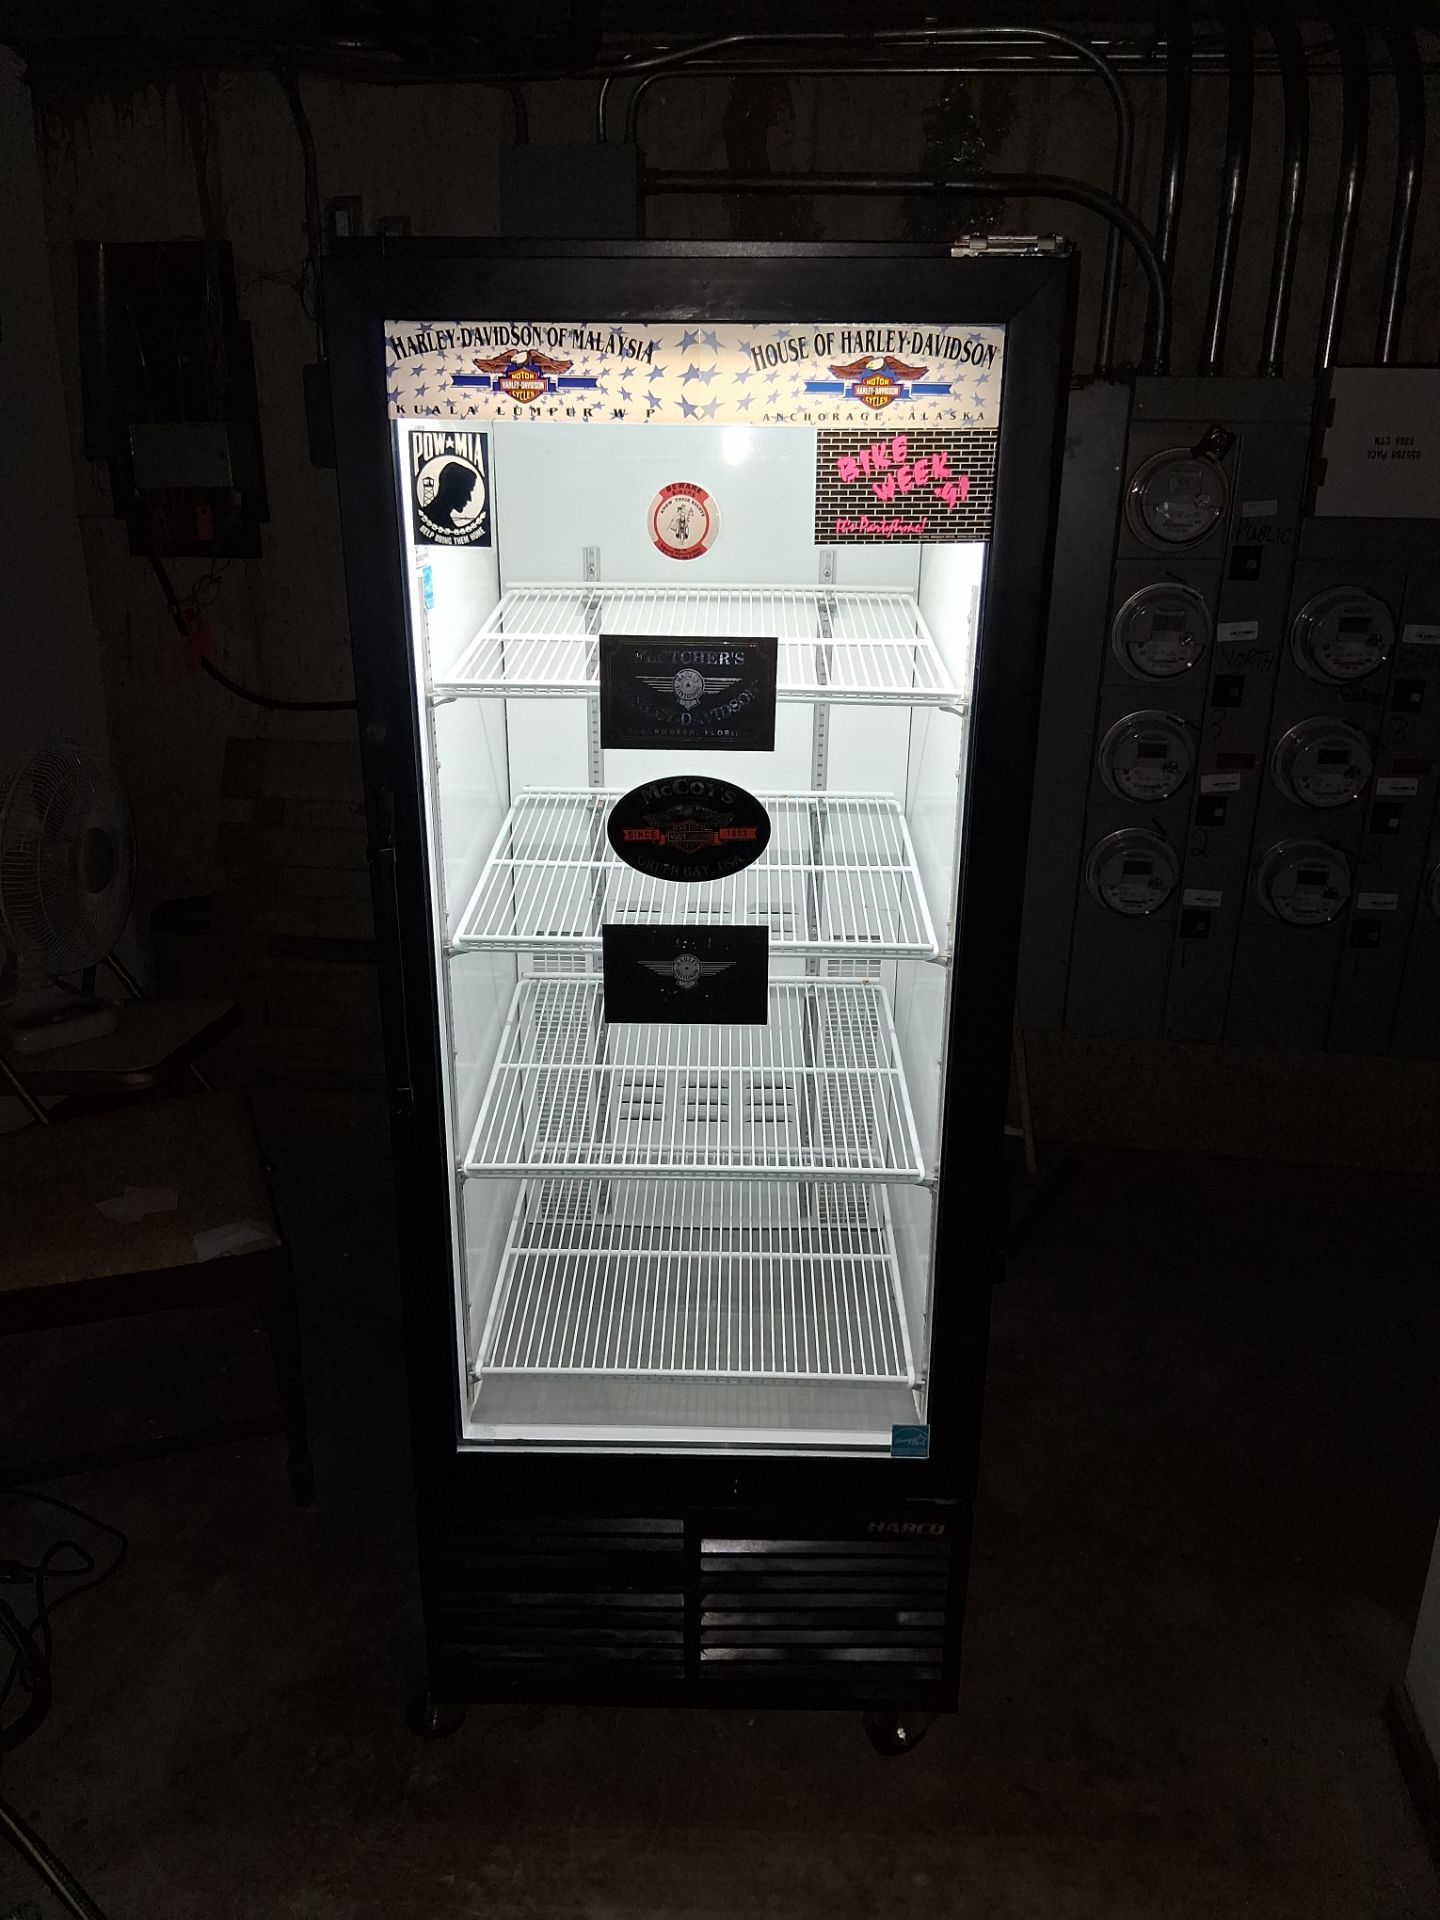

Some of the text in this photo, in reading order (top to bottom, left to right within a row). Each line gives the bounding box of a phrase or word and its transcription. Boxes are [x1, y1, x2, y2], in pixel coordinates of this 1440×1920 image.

[550, 328, 568, 347] OF
[572, 330, 653, 364] MALAYSIA
[751, 336, 808, 372] HOUSE
[814, 332, 835, 357] OF
[396, 404, 477, 416] KUALA
[496, 406, 594, 418] LUMPUR
[908, 412, 985, 422] ALASKA
[412, 432, 486, 478] POW MIA
[837, 435, 908, 483] BIKE
[872, 452, 950, 502] WEEK
[628, 830, 657, 839] SINCE
